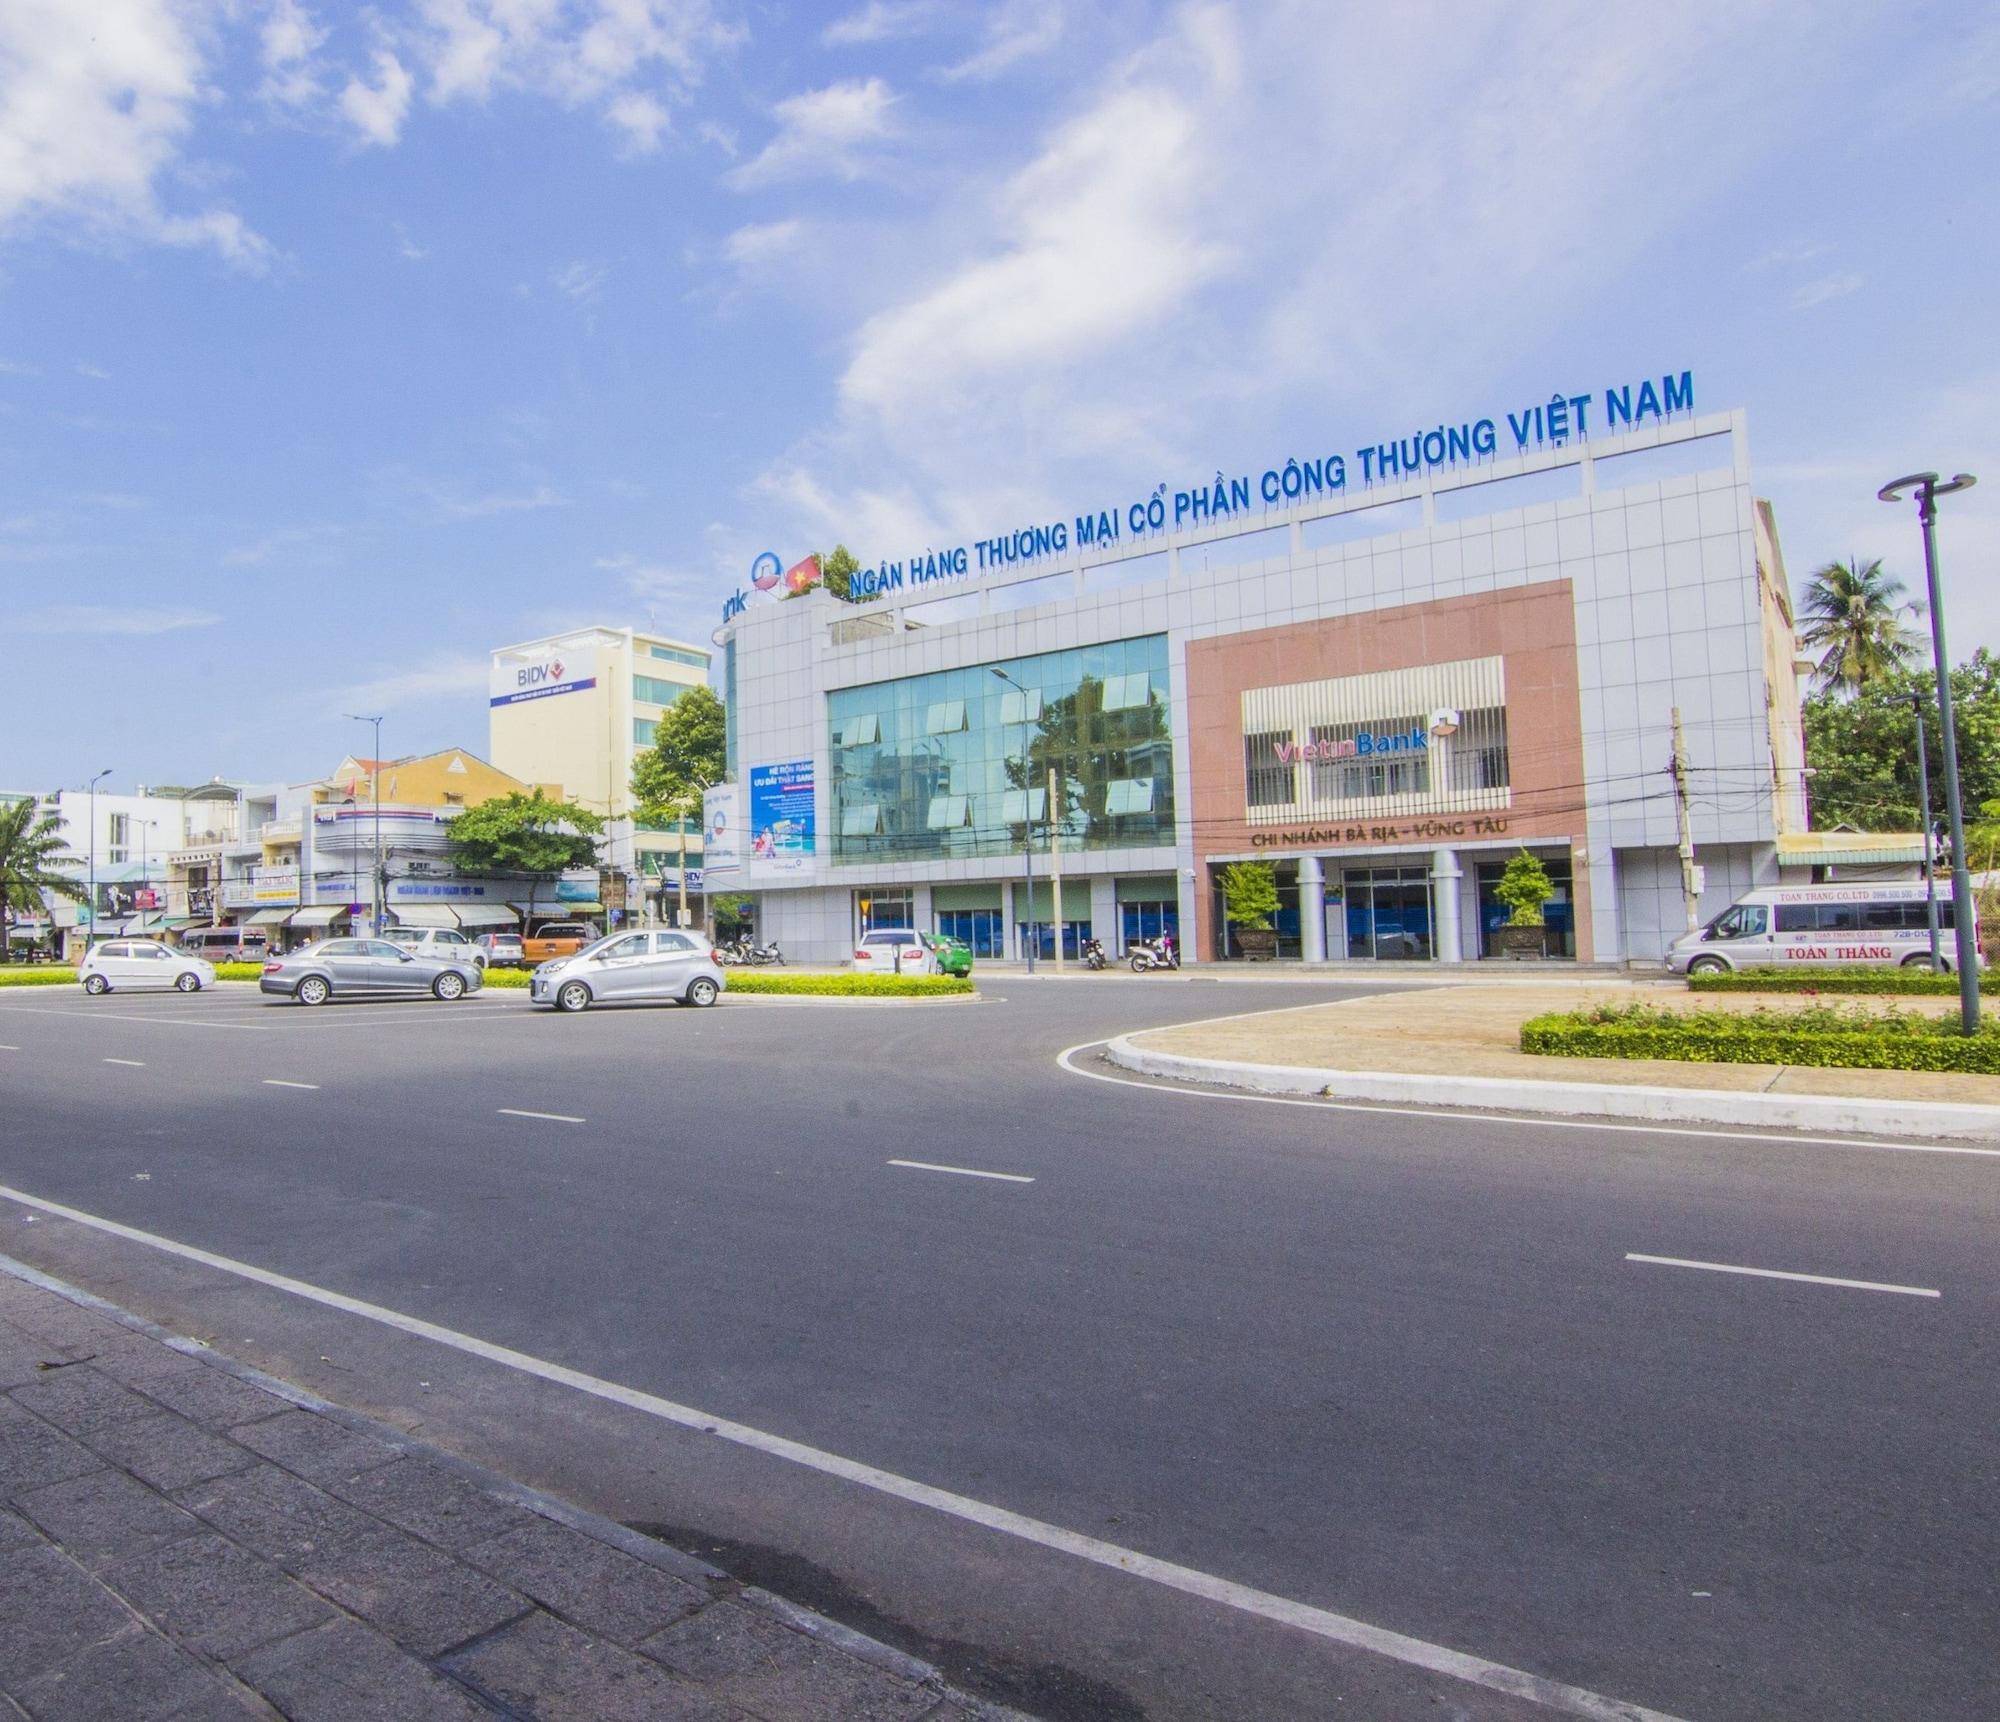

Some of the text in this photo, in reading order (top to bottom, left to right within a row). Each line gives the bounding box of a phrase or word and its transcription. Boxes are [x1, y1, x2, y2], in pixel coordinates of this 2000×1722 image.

[848, 370, 1695, 598] NGÂN HÀNG THƯƠNG MẠI CỔ PHẦN CÔNG THƯƠNG VIỆT NAM
[517, 663, 550, 687] BIDV
[1273, 727, 1429, 763] VietinBank
[1251, 832, 1278, 848] CHI
[1281, 825, 1341, 845] NHÁNH
[1346, 824, 1368, 843] BÀ
[1371, 825, 1398, 844] RỊA
[1412, 819, 1465, 838] VŨNG
[1473, 815, 1508, 835] TÀU
